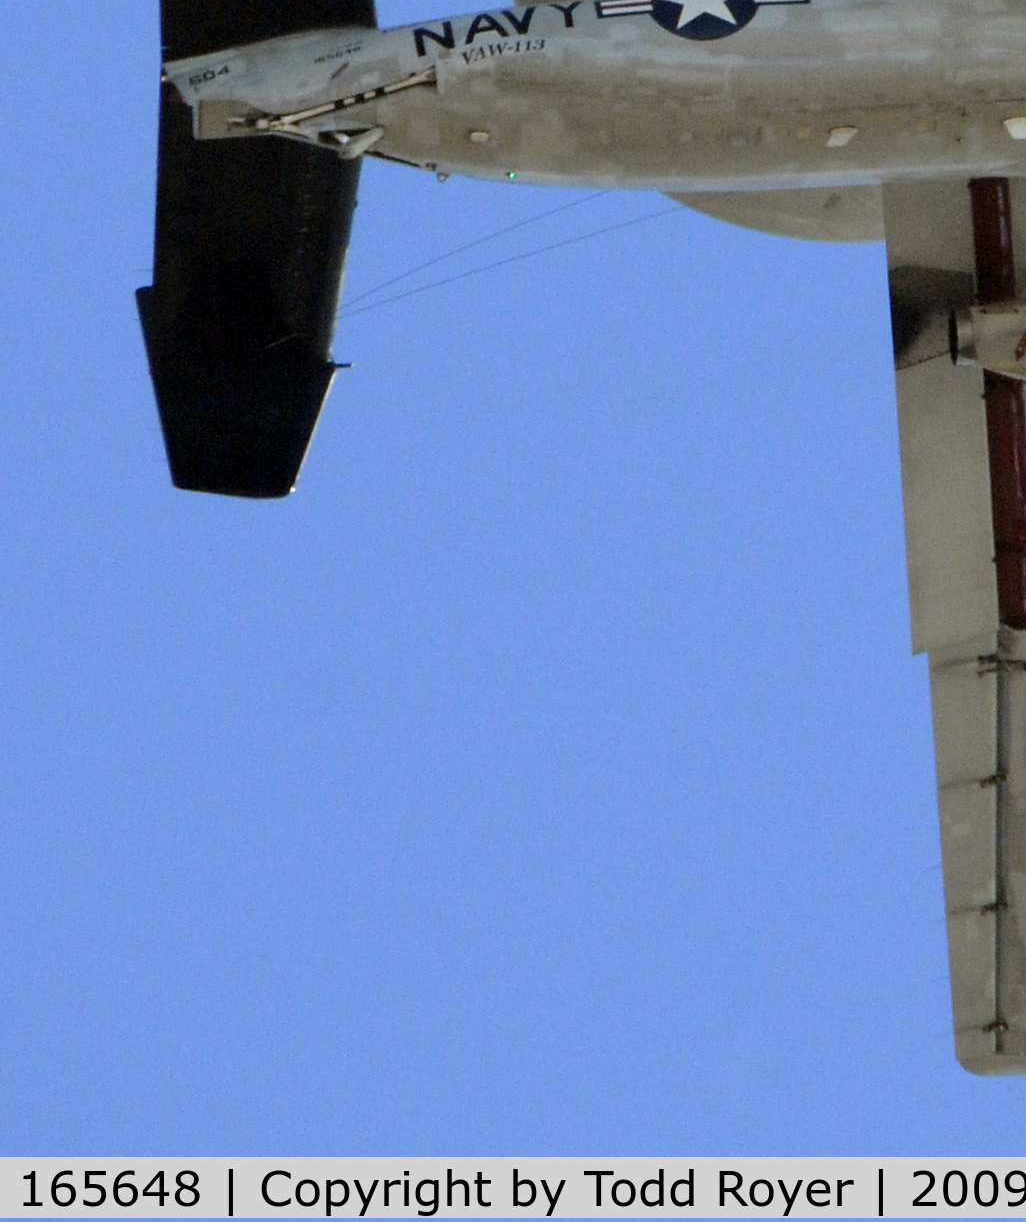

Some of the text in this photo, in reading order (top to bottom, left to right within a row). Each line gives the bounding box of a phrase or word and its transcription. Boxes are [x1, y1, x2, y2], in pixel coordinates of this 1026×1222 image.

[413, 0, 582, 57] NAVY
[462, 39, 546, 65] VAW-113
[188, 66, 229, 85] 604
